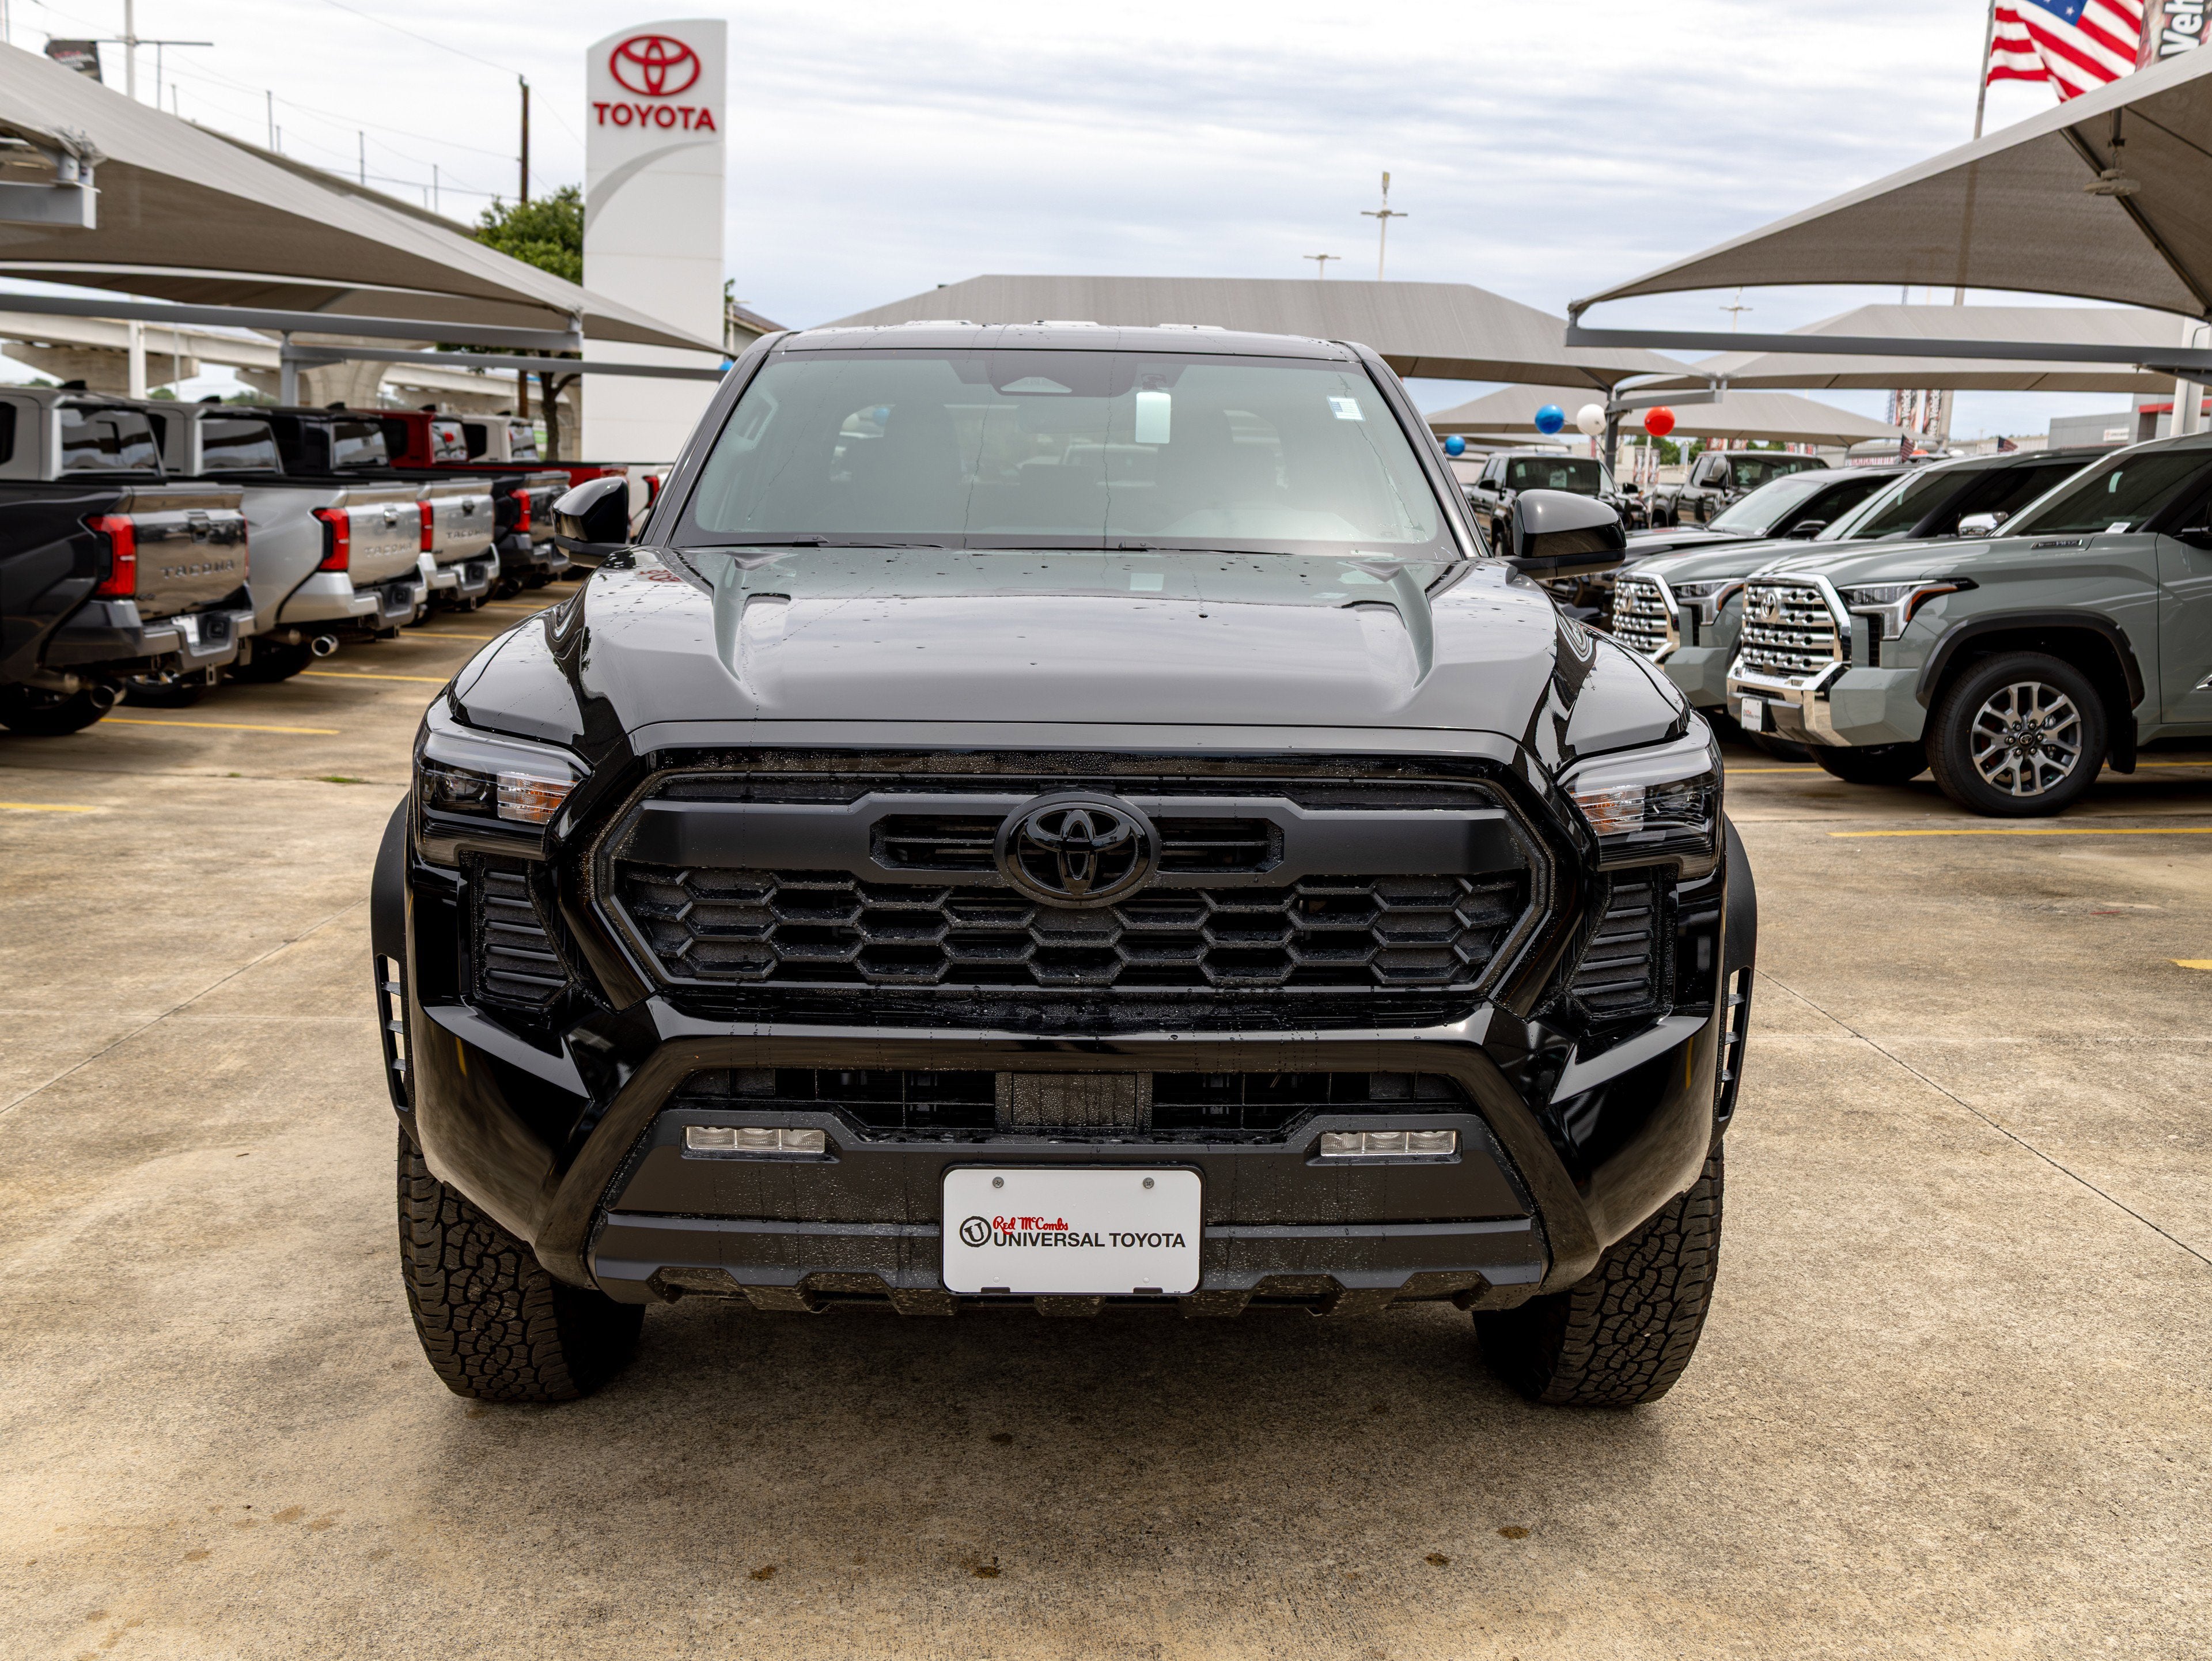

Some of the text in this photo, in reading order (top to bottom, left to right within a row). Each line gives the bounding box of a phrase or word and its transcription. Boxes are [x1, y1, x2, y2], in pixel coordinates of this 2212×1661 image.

[2160, 0, 2204, 56] Veh
[593, 102, 716, 133] TOYOTA
[160, 559, 234, 580] TACOMA
[993, 1216, 1069, 1235] Red McCombs
[994, 1232, 1186, 1248] UNIVERSAL TOYOTA
